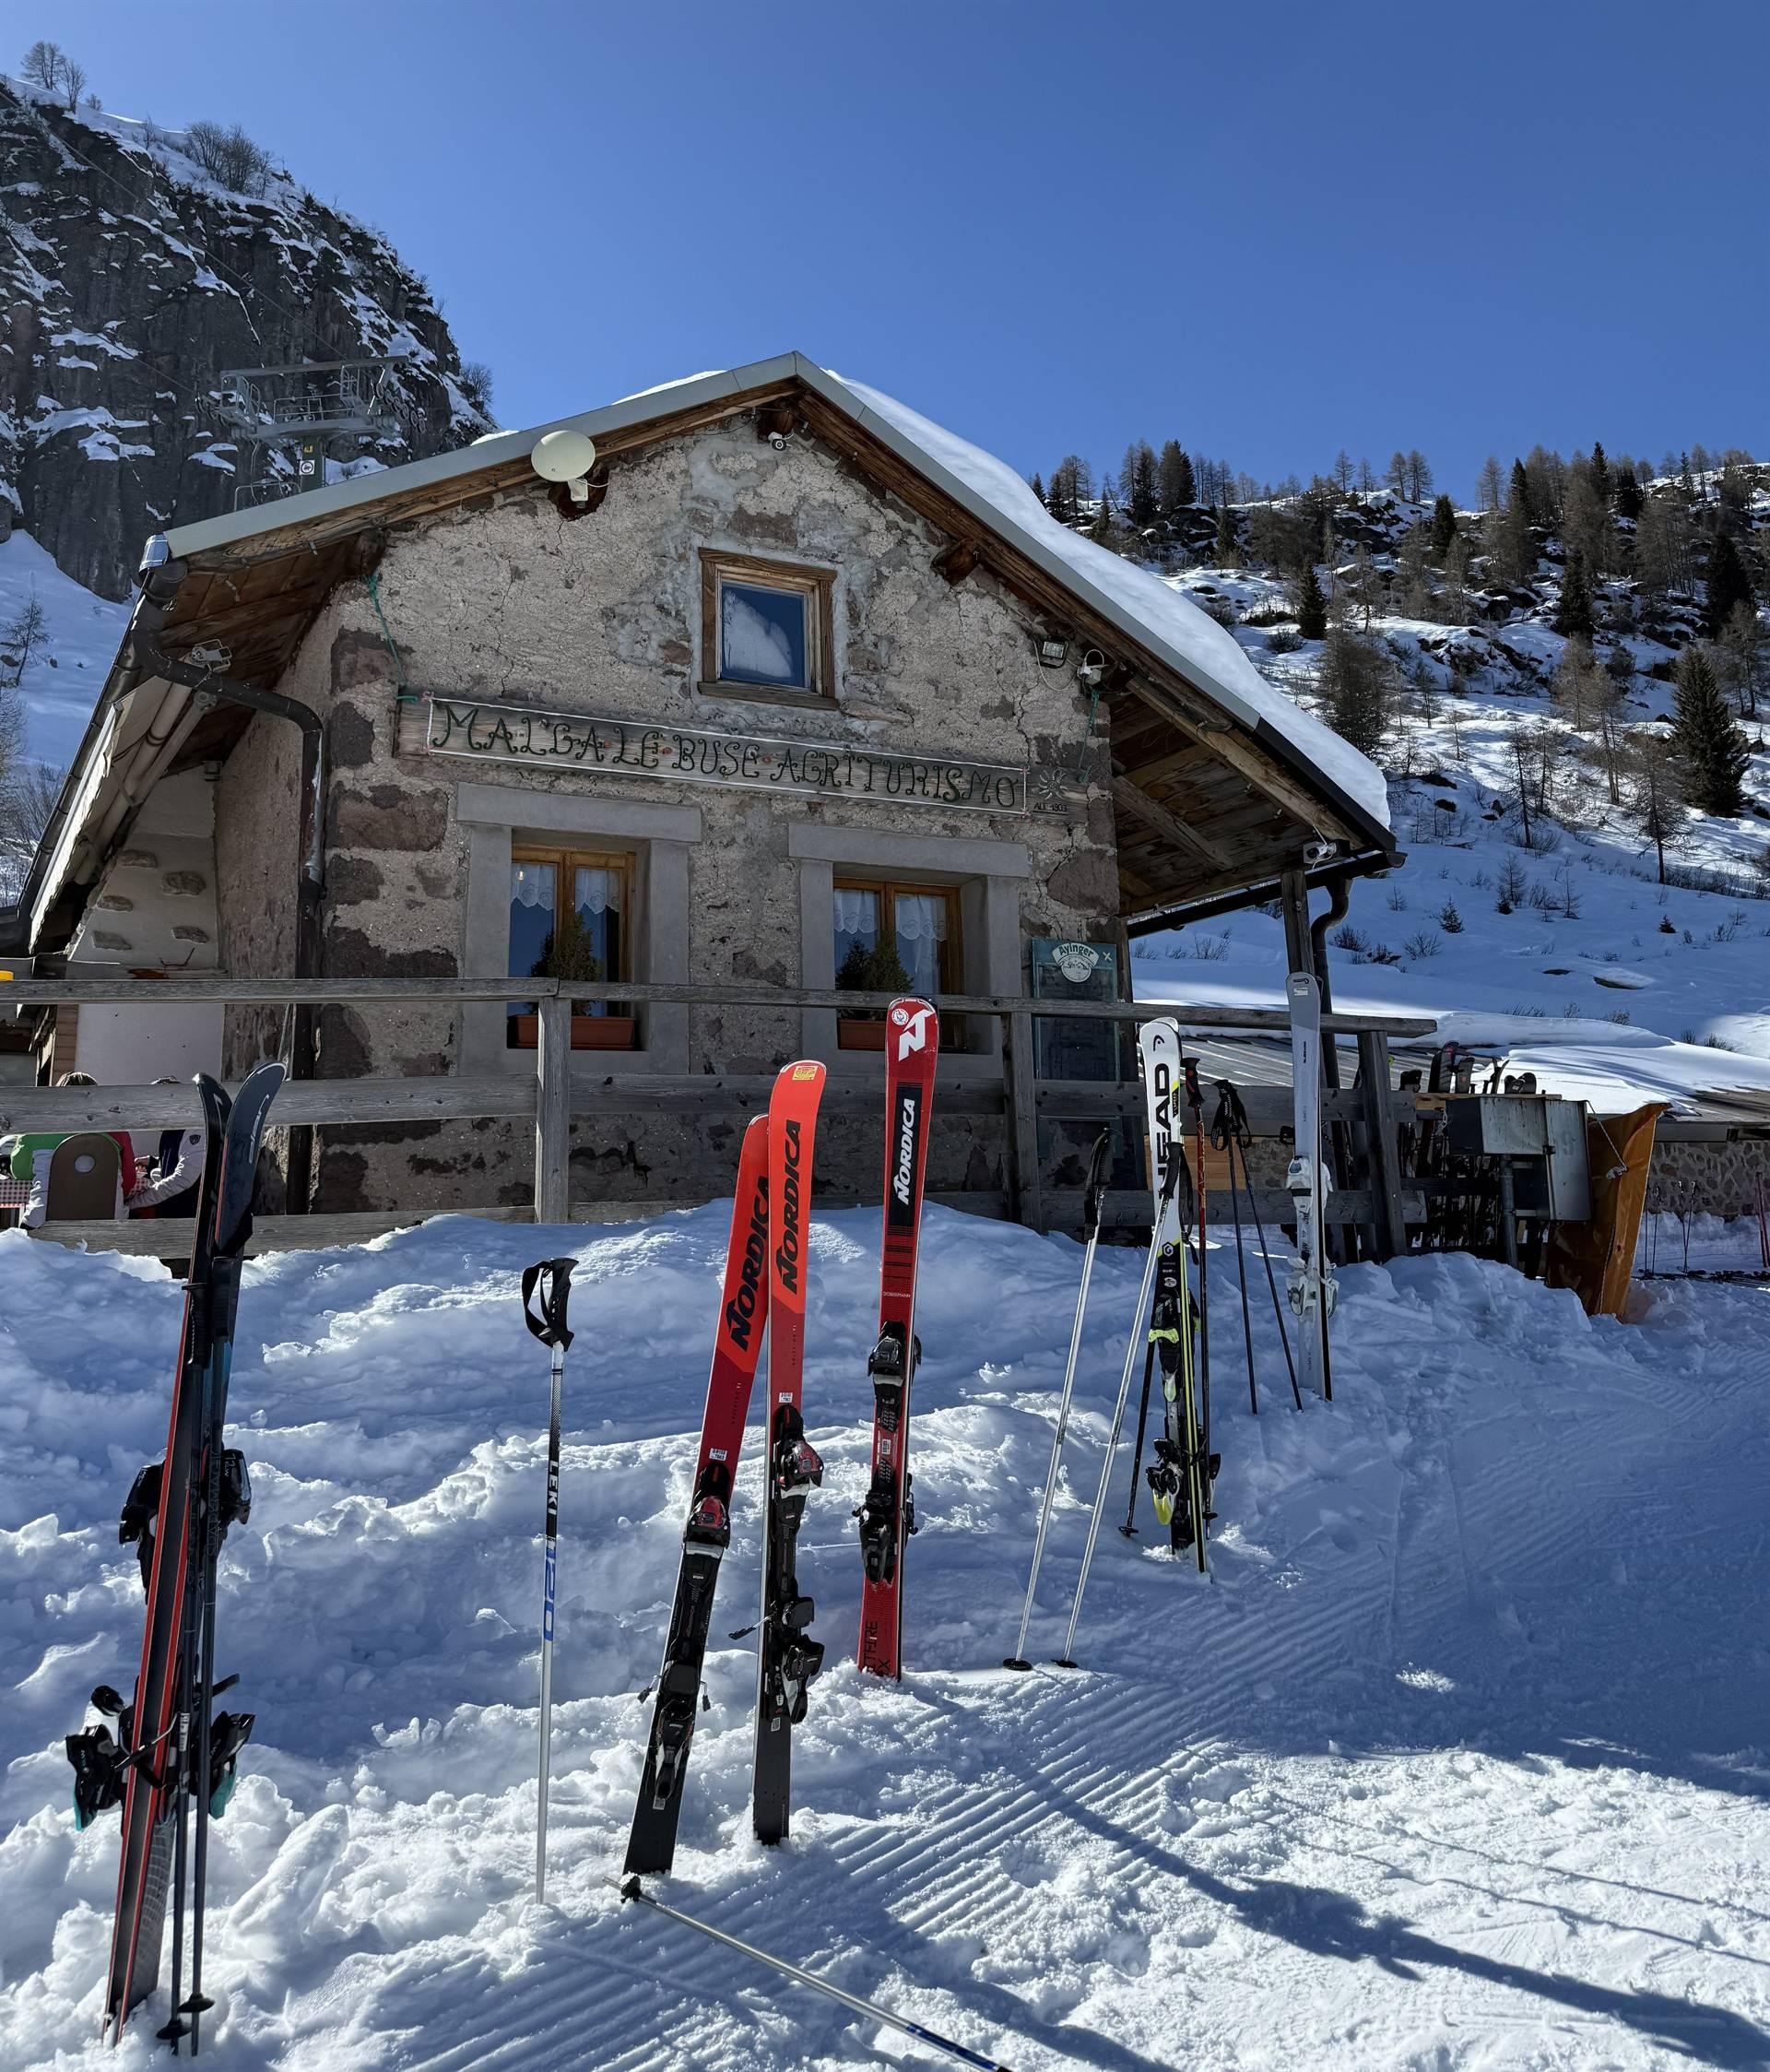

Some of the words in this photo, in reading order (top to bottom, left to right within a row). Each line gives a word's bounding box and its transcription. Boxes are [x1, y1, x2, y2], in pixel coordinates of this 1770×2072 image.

[671, 734, 760, 778] BUSE
[1057, 942, 1095, 957] Ayinger
[893, 1098, 915, 1206] NORDICA
[775, 1119, 802, 1296] NORDICA
[726, 1174, 769, 1352] NORDICA
[547, 1460, 559, 1516] LEKI
